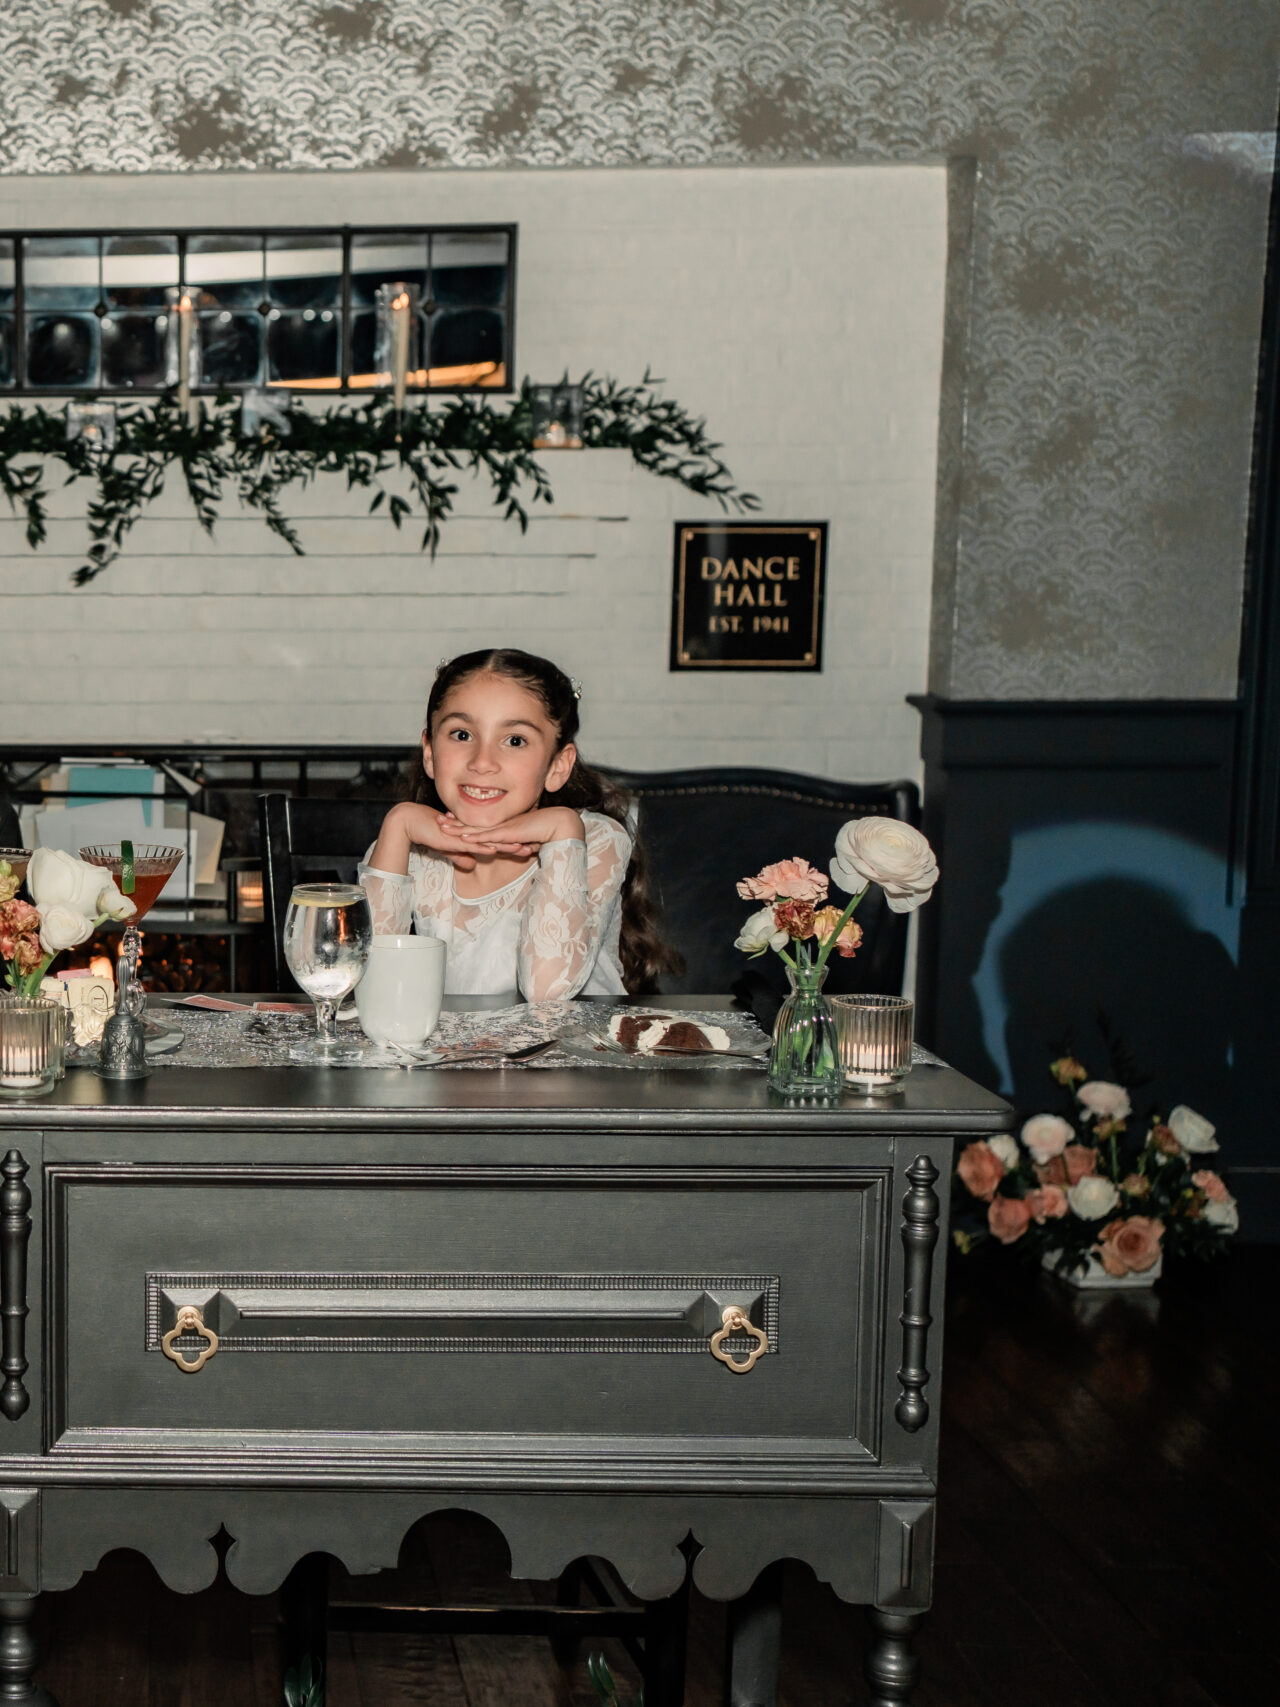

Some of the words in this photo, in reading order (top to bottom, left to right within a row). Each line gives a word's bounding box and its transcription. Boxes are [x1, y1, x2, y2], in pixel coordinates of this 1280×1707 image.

[701, 556, 801, 581] DANCE
[714, 583, 788, 607] HALL
[753, 616, 790, 633] 1941
